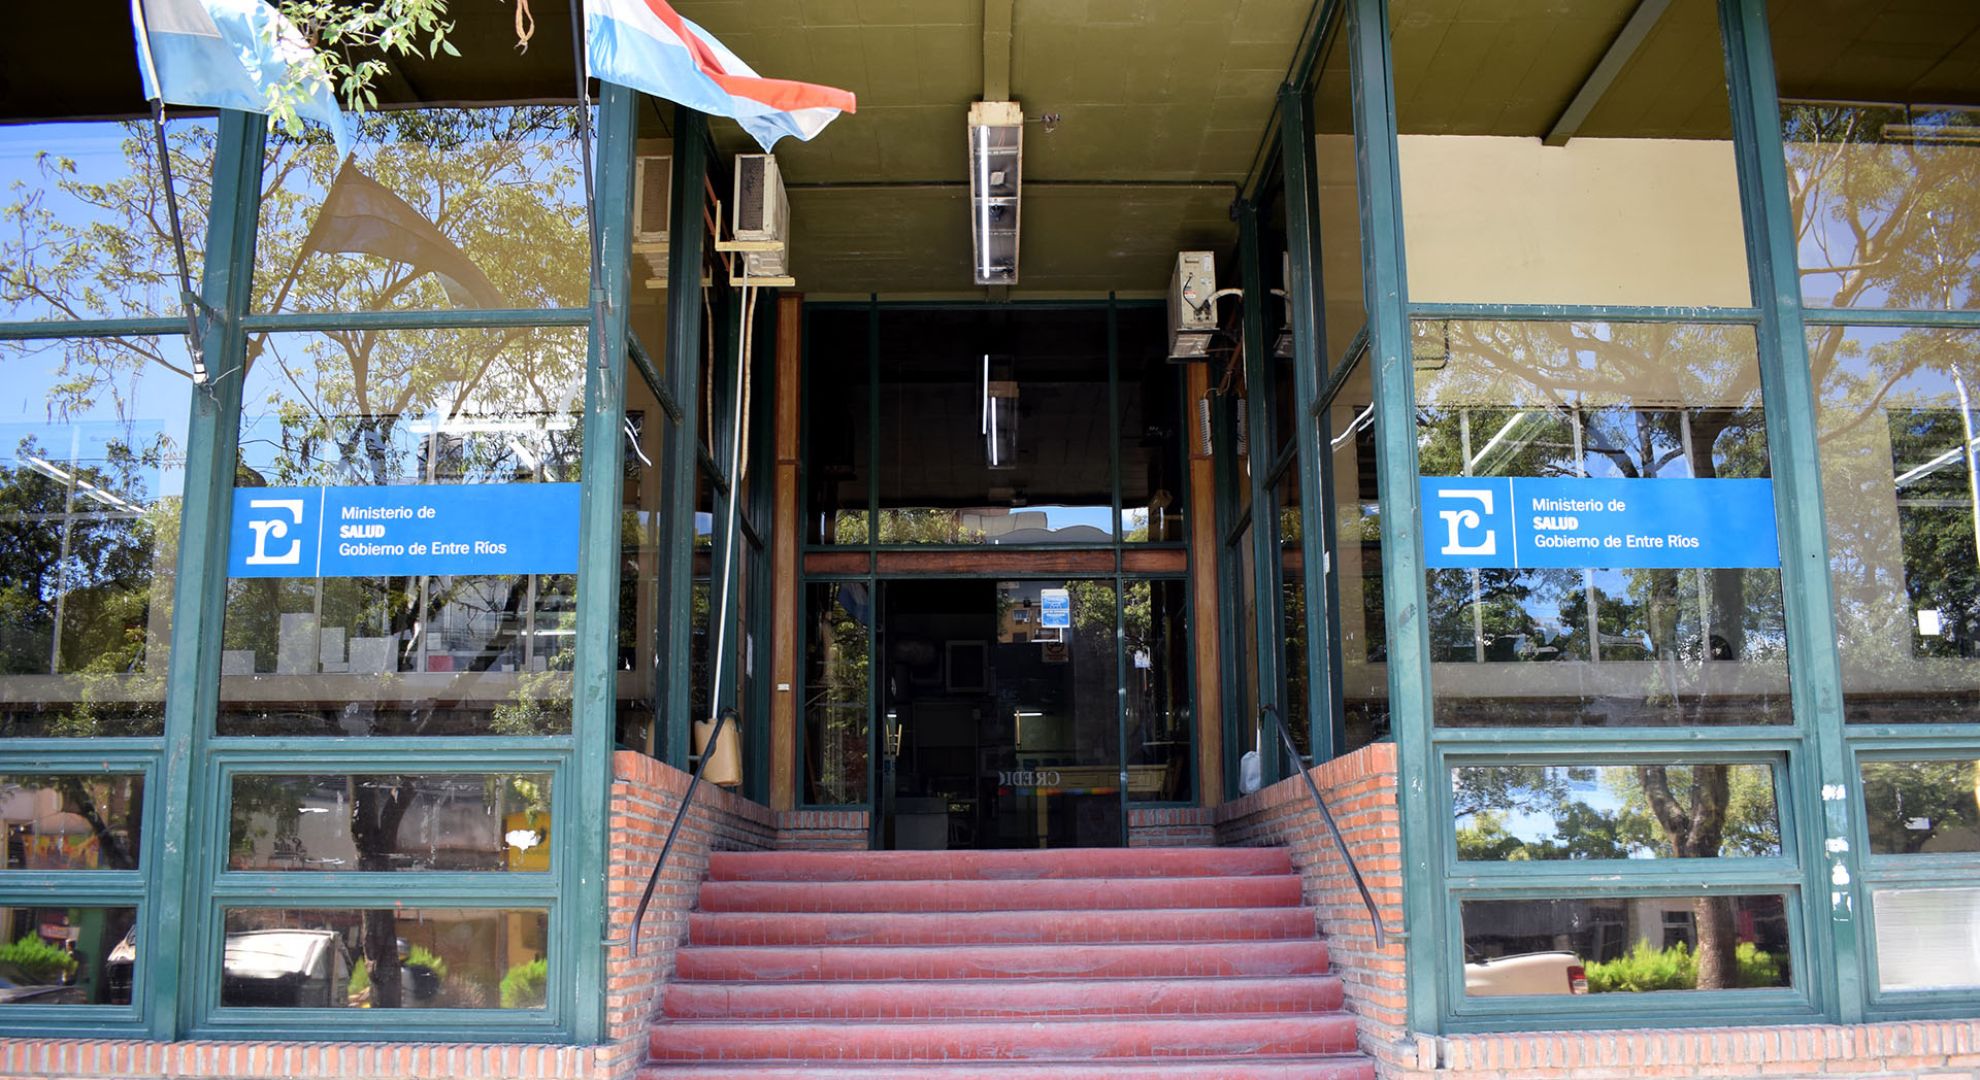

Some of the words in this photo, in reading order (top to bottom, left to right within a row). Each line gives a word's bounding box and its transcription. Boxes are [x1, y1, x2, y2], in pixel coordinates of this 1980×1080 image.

[341, 505, 414, 520] Ministerio
[416, 505, 436, 519] de
[1532, 498, 1604, 512] Ministerio
[1607, 498, 1626, 512] de
[1532, 516, 1579, 531] SALUD
[339, 524, 386, 539] SALUD
[338, 542, 405, 556] Gobierno
[407, 542, 427, 556] de
[431, 541, 470, 555] Entre
[474, 539, 508, 555] Ríos
[1534, 534, 1600, 548] Gobierno
[1603, 534, 1622, 548] de
[1626, 534, 1664, 548] Entre
[1667, 534, 1700, 548] Ríos
